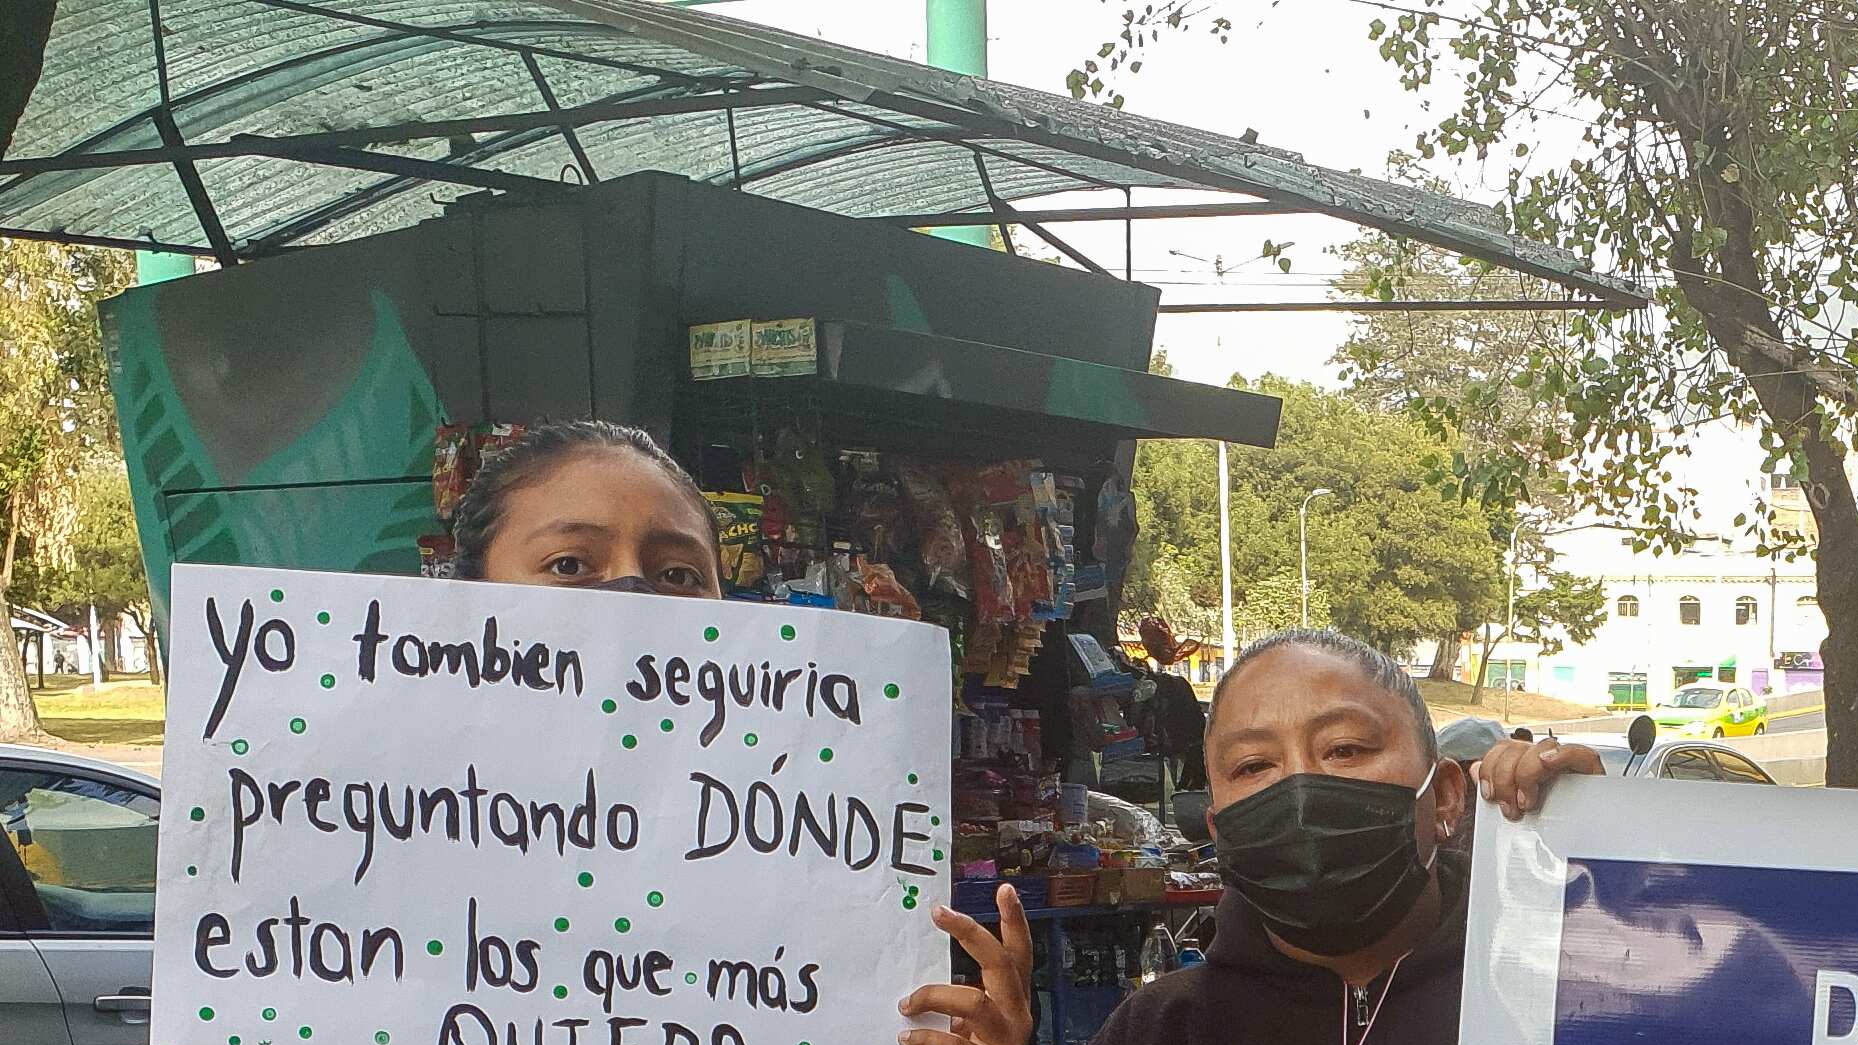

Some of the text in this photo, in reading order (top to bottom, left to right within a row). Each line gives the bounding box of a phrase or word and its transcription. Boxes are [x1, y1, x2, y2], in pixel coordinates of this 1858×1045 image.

[354, 600, 584, 697] tambien
[229, 753, 938, 885] preguntando DÓNDE
[193, 896, 820, 1014] estan los que más
